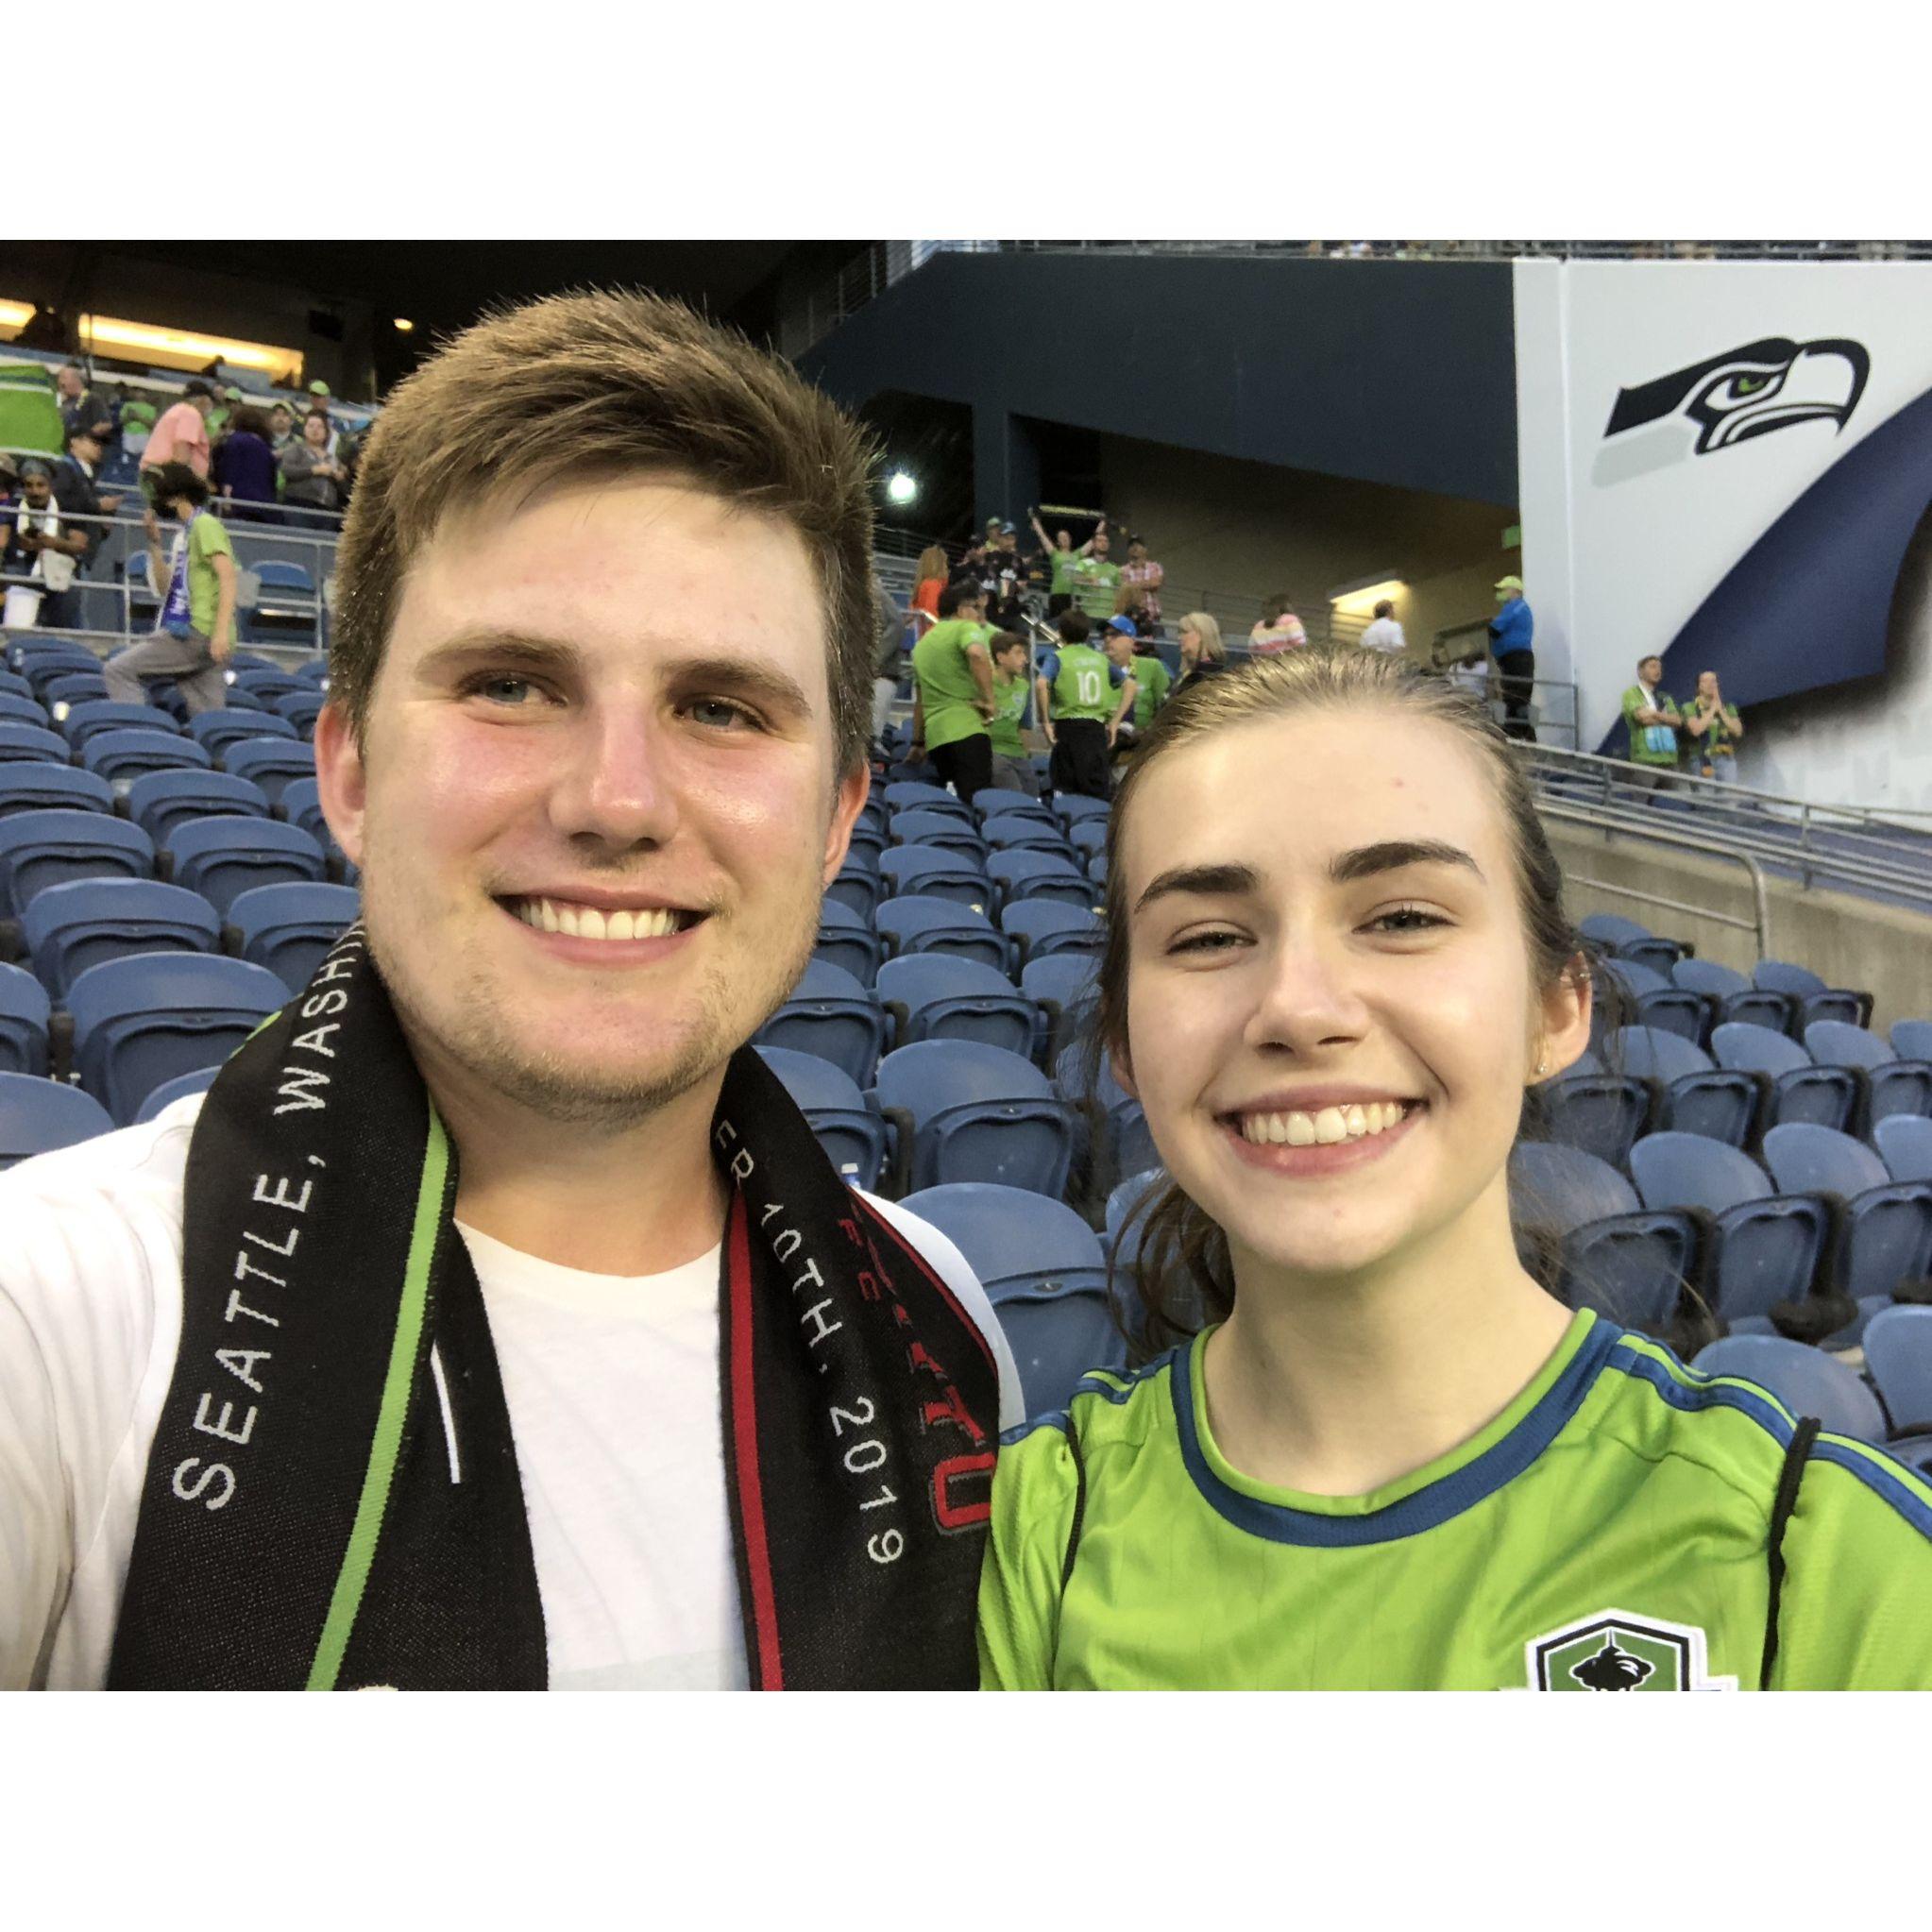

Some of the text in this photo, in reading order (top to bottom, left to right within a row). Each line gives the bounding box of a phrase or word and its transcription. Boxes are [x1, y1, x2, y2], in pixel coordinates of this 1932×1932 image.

[1076, 670, 1101, 704] 10
[172, 1154, 327, 1511] SEATTLE,
[829, 1396, 905, 1565] 2019
